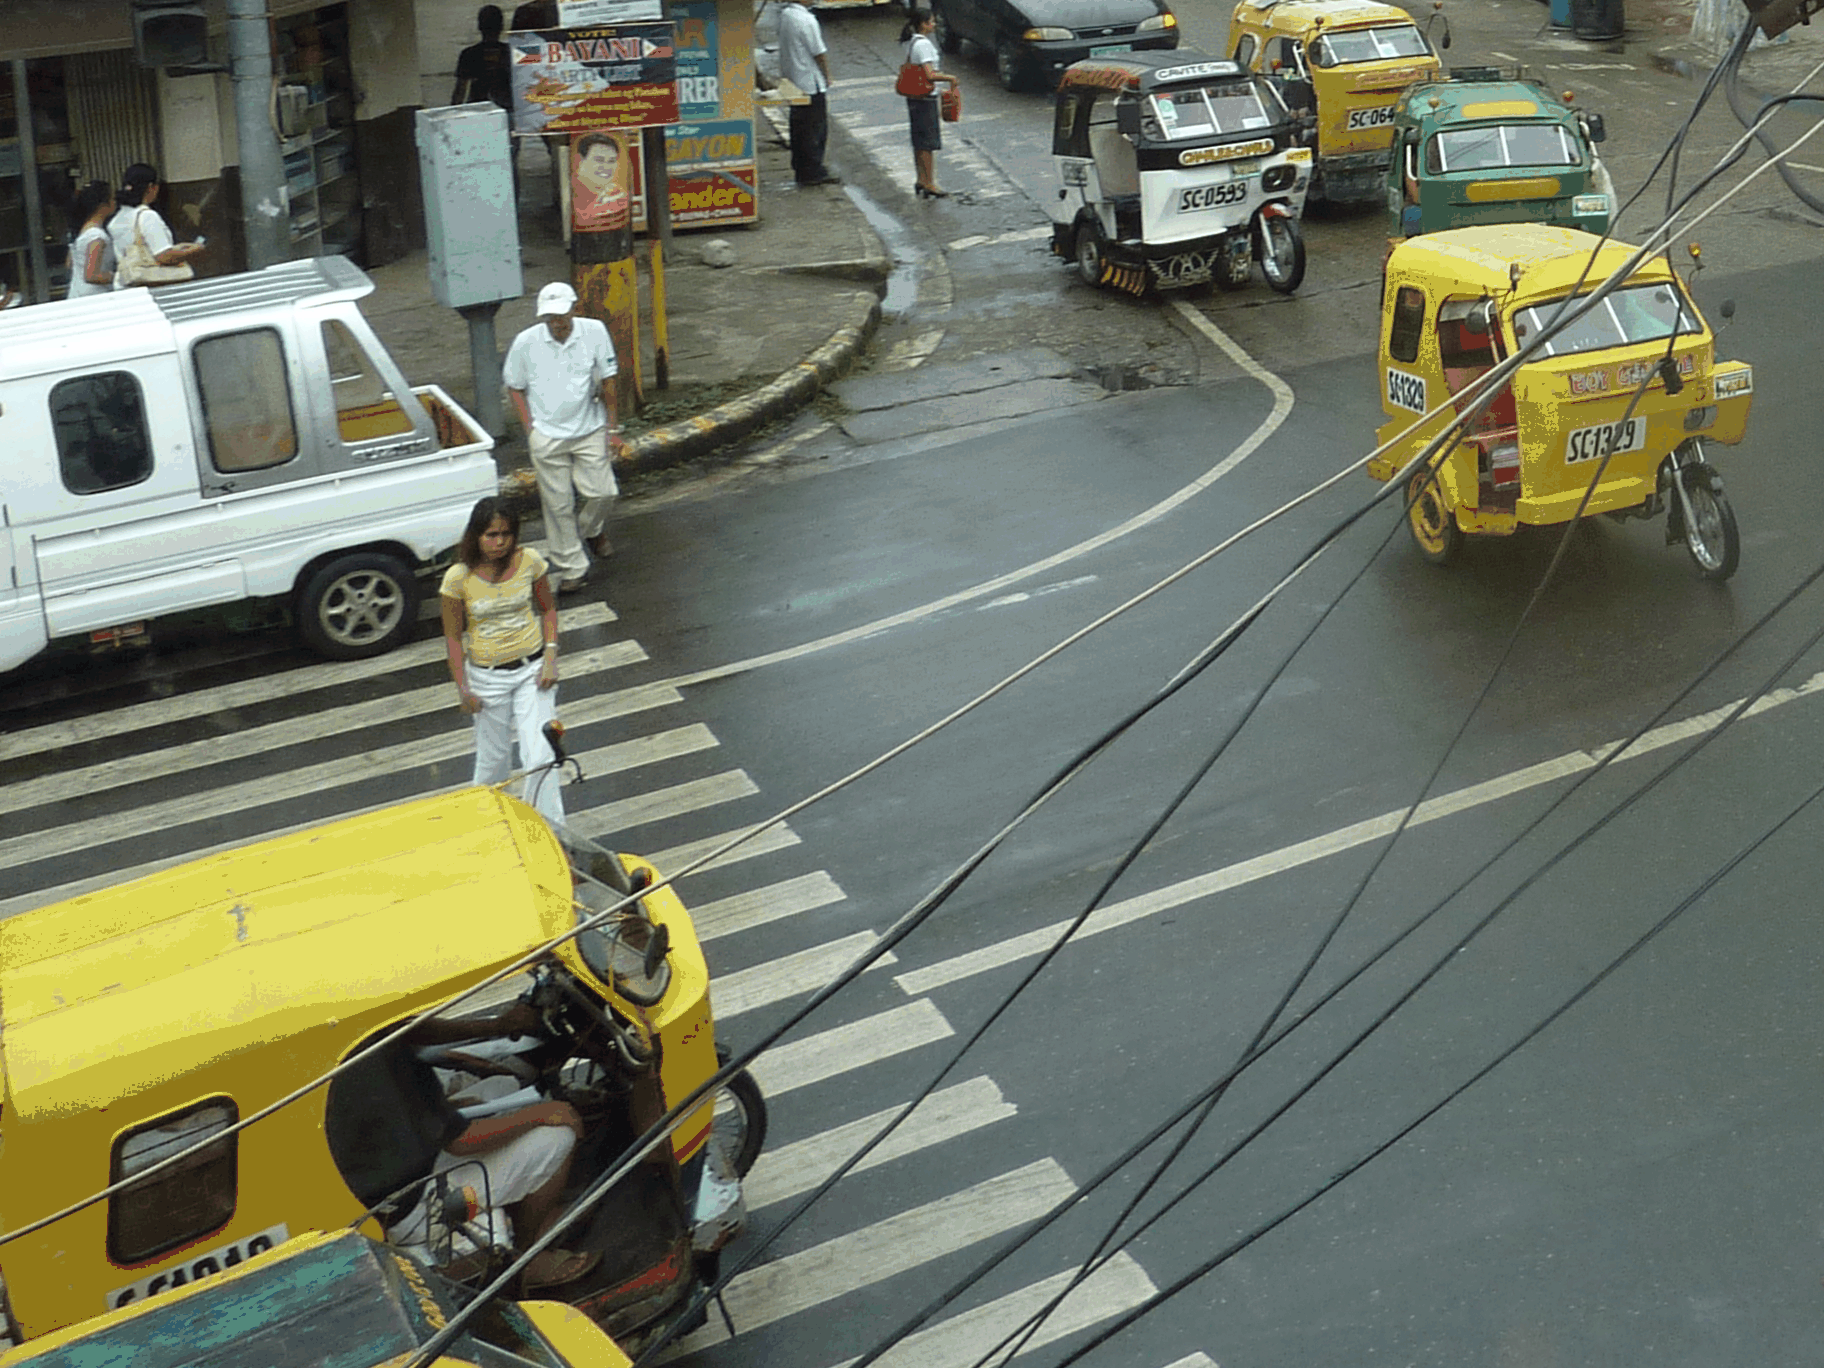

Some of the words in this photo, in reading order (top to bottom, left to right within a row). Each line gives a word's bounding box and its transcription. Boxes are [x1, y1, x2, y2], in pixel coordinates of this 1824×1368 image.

[547, 37, 641, 63] BAYANI
[1158, 63, 1206, 81] CAVITE
[1181, 182, 1247, 211] SC-0593
